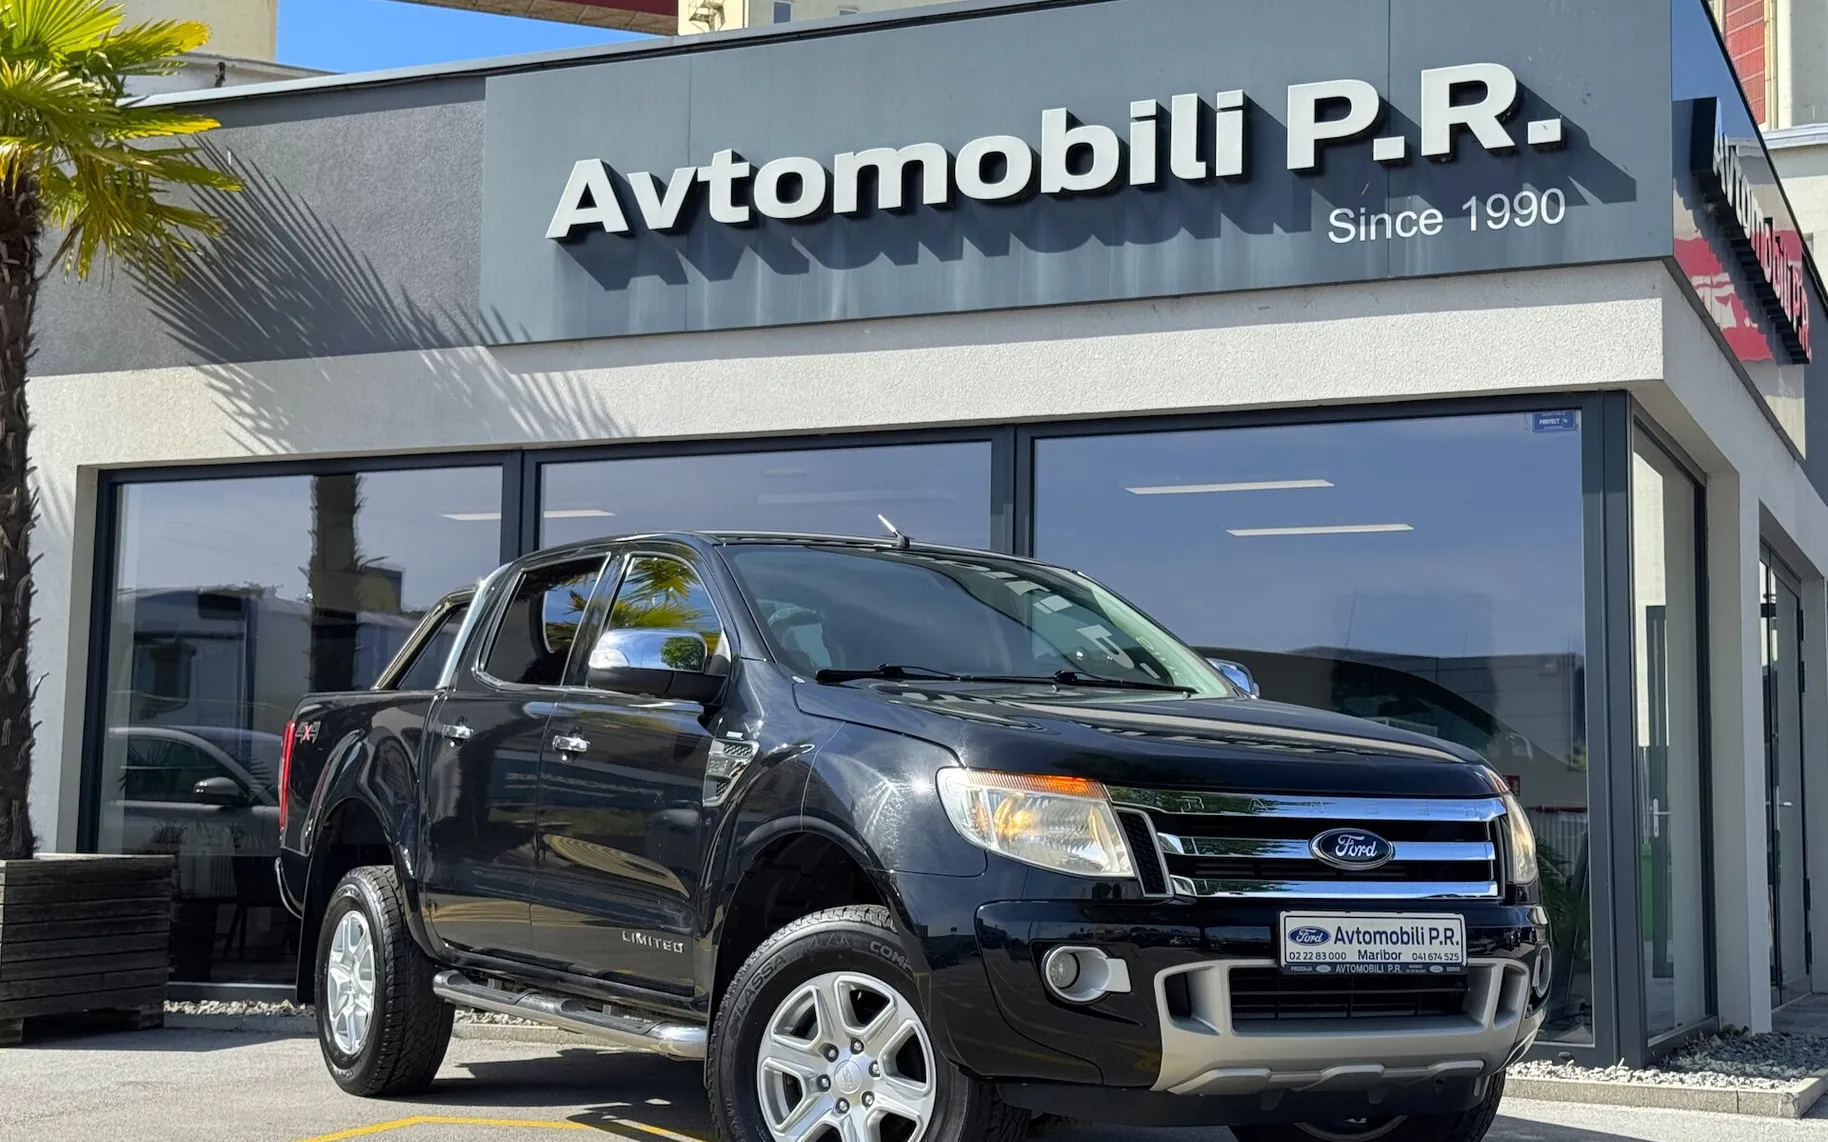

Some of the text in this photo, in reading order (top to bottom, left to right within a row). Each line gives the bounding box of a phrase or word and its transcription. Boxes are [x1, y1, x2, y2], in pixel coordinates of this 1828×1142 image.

[545, 63, 1562, 240] Avtomobili P.R.
[1328, 188, 1566, 243] Since 1990
[1335, 834, 1378, 857] Ford
[622, 931, 685, 954] LIMITED
[1296, 926, 1460, 946] Ford Avtomobili P.R.
[1328, 952, 1347, 961] 000
[1357, 949, 1402, 961] Maribor
[1412, 952, 1426, 961] 041
[1444, 952, 1460, 961] 525
[1335, 964, 1384, 974] AVTOMOBILI
[1387, 964, 1403, 974] P.R.
